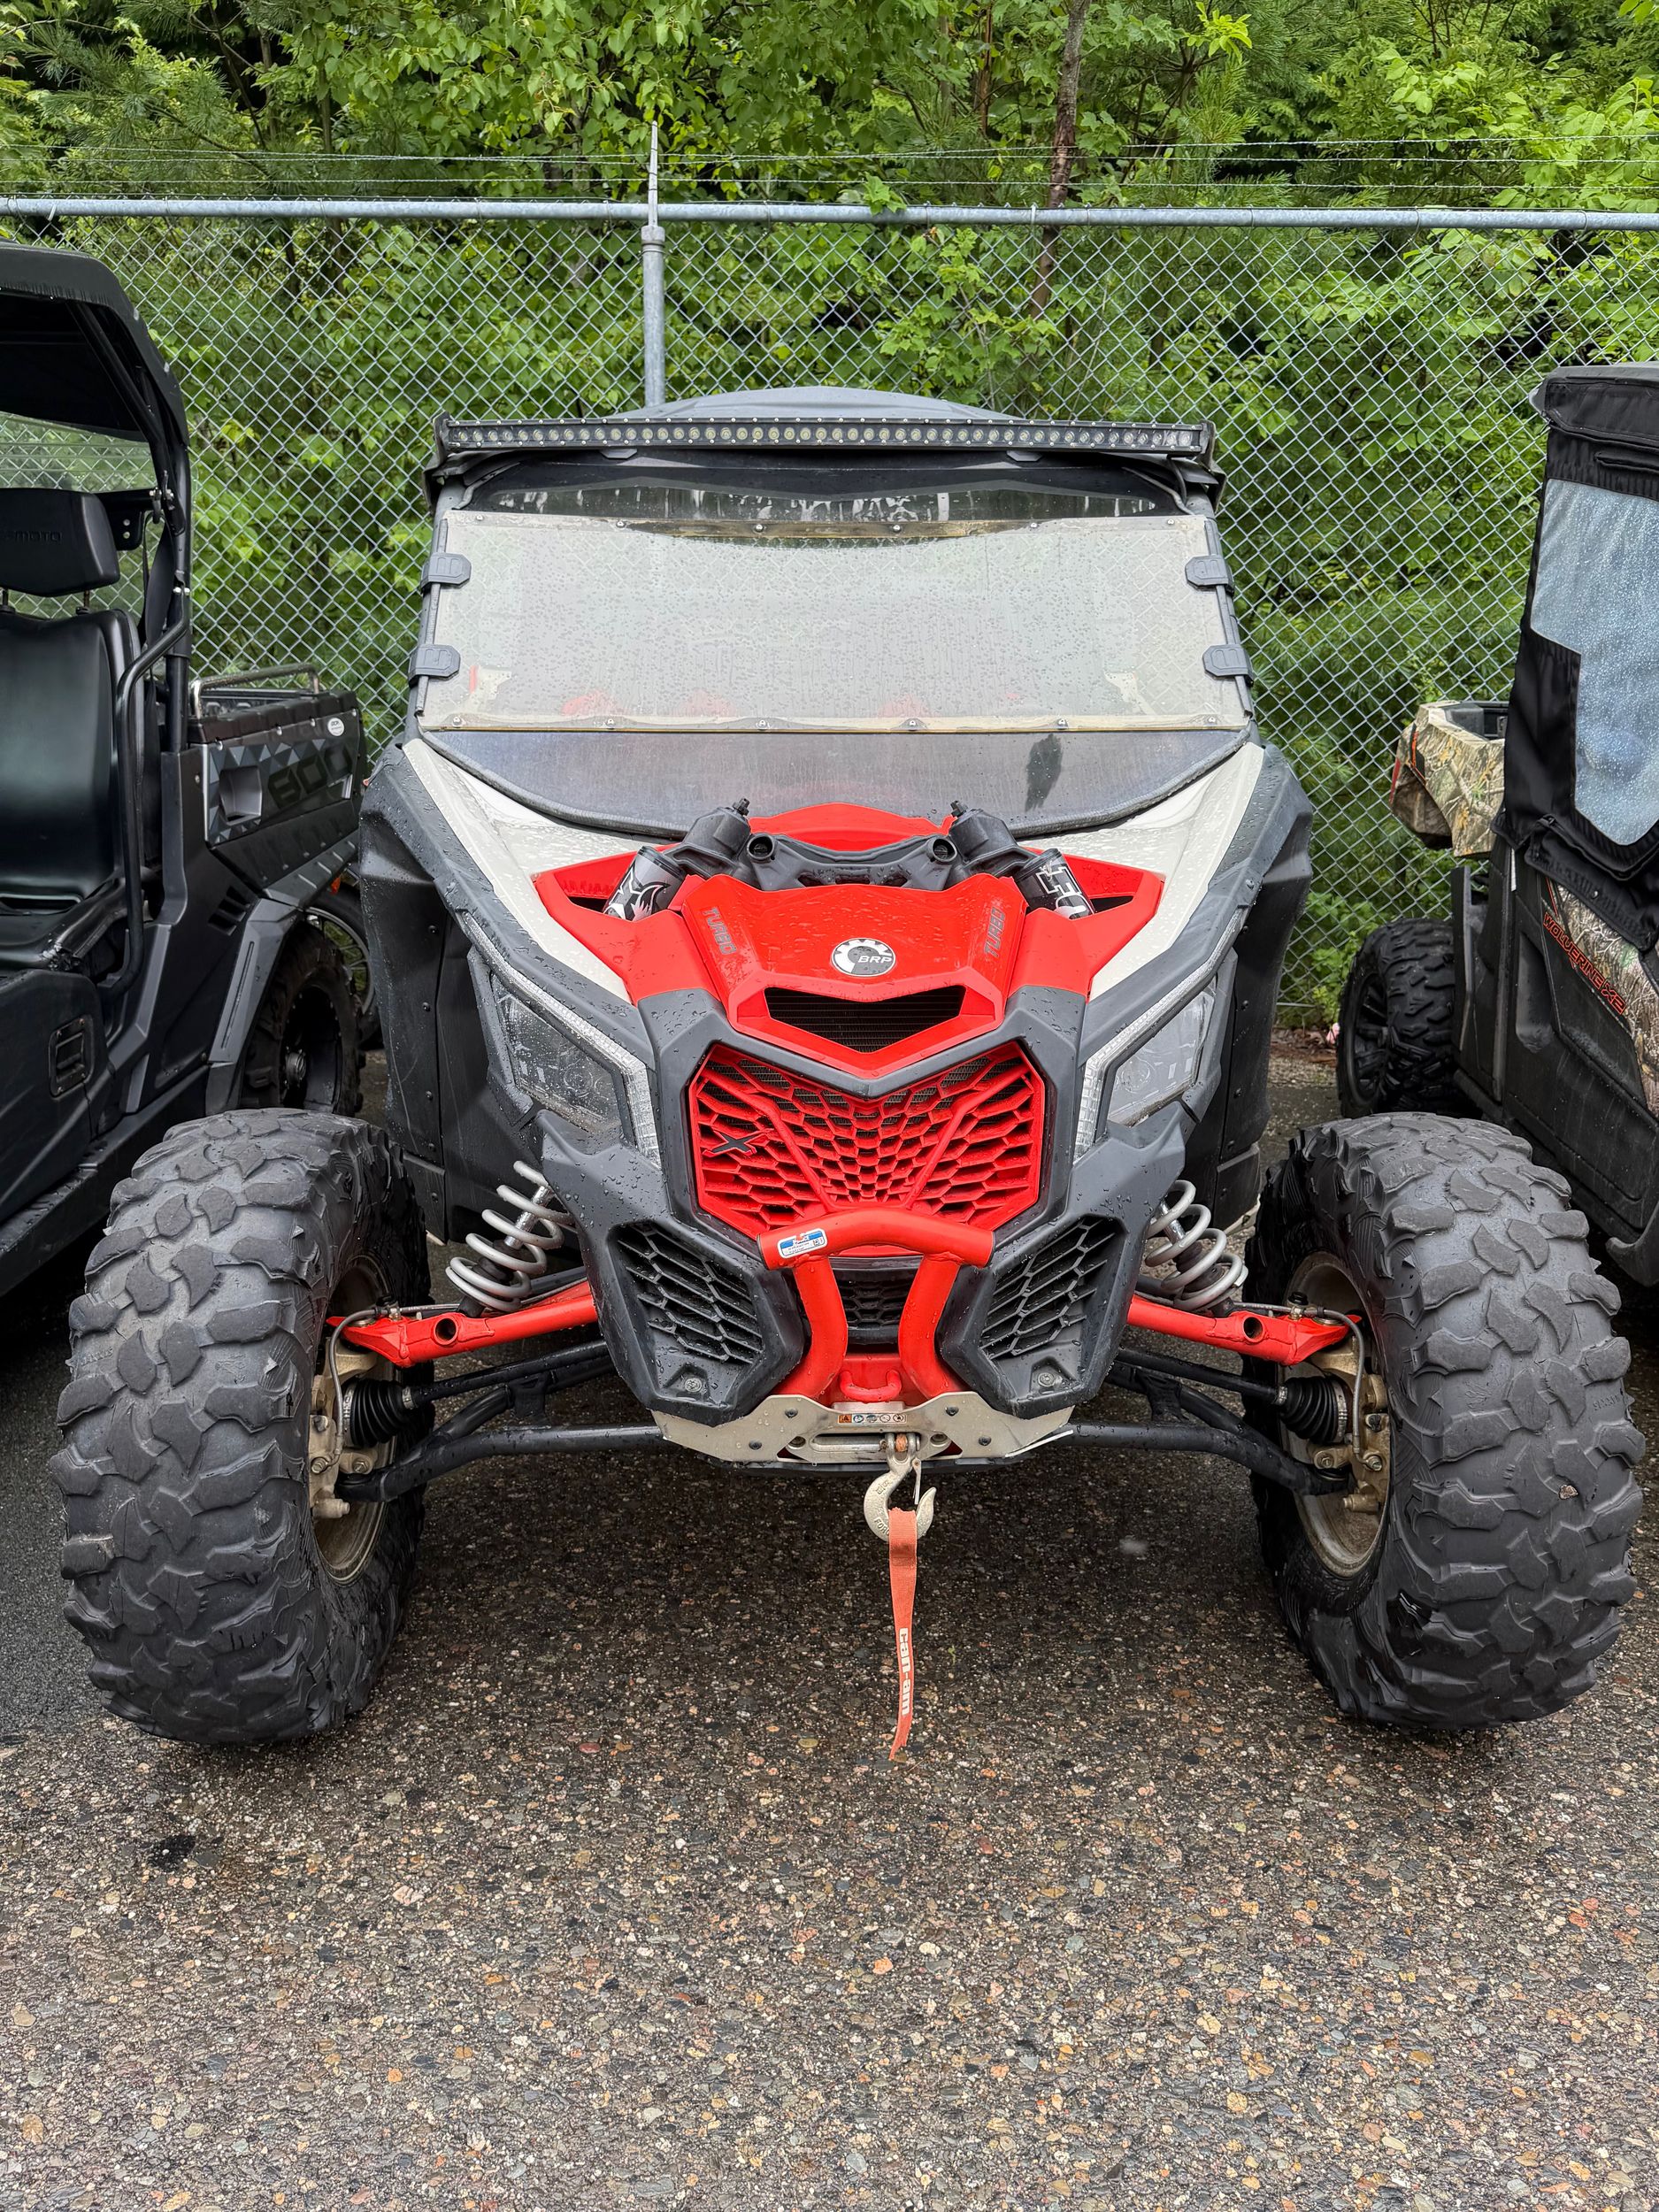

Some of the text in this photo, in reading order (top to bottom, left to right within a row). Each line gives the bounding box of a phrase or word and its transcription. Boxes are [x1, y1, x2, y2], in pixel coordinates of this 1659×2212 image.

[702, 906, 737, 955] TURBO
[984, 906, 1006, 958] TURBO
[857, 955, 893, 964] BRP
[1542, 911, 1626, 1015] WOLVERINE X2
